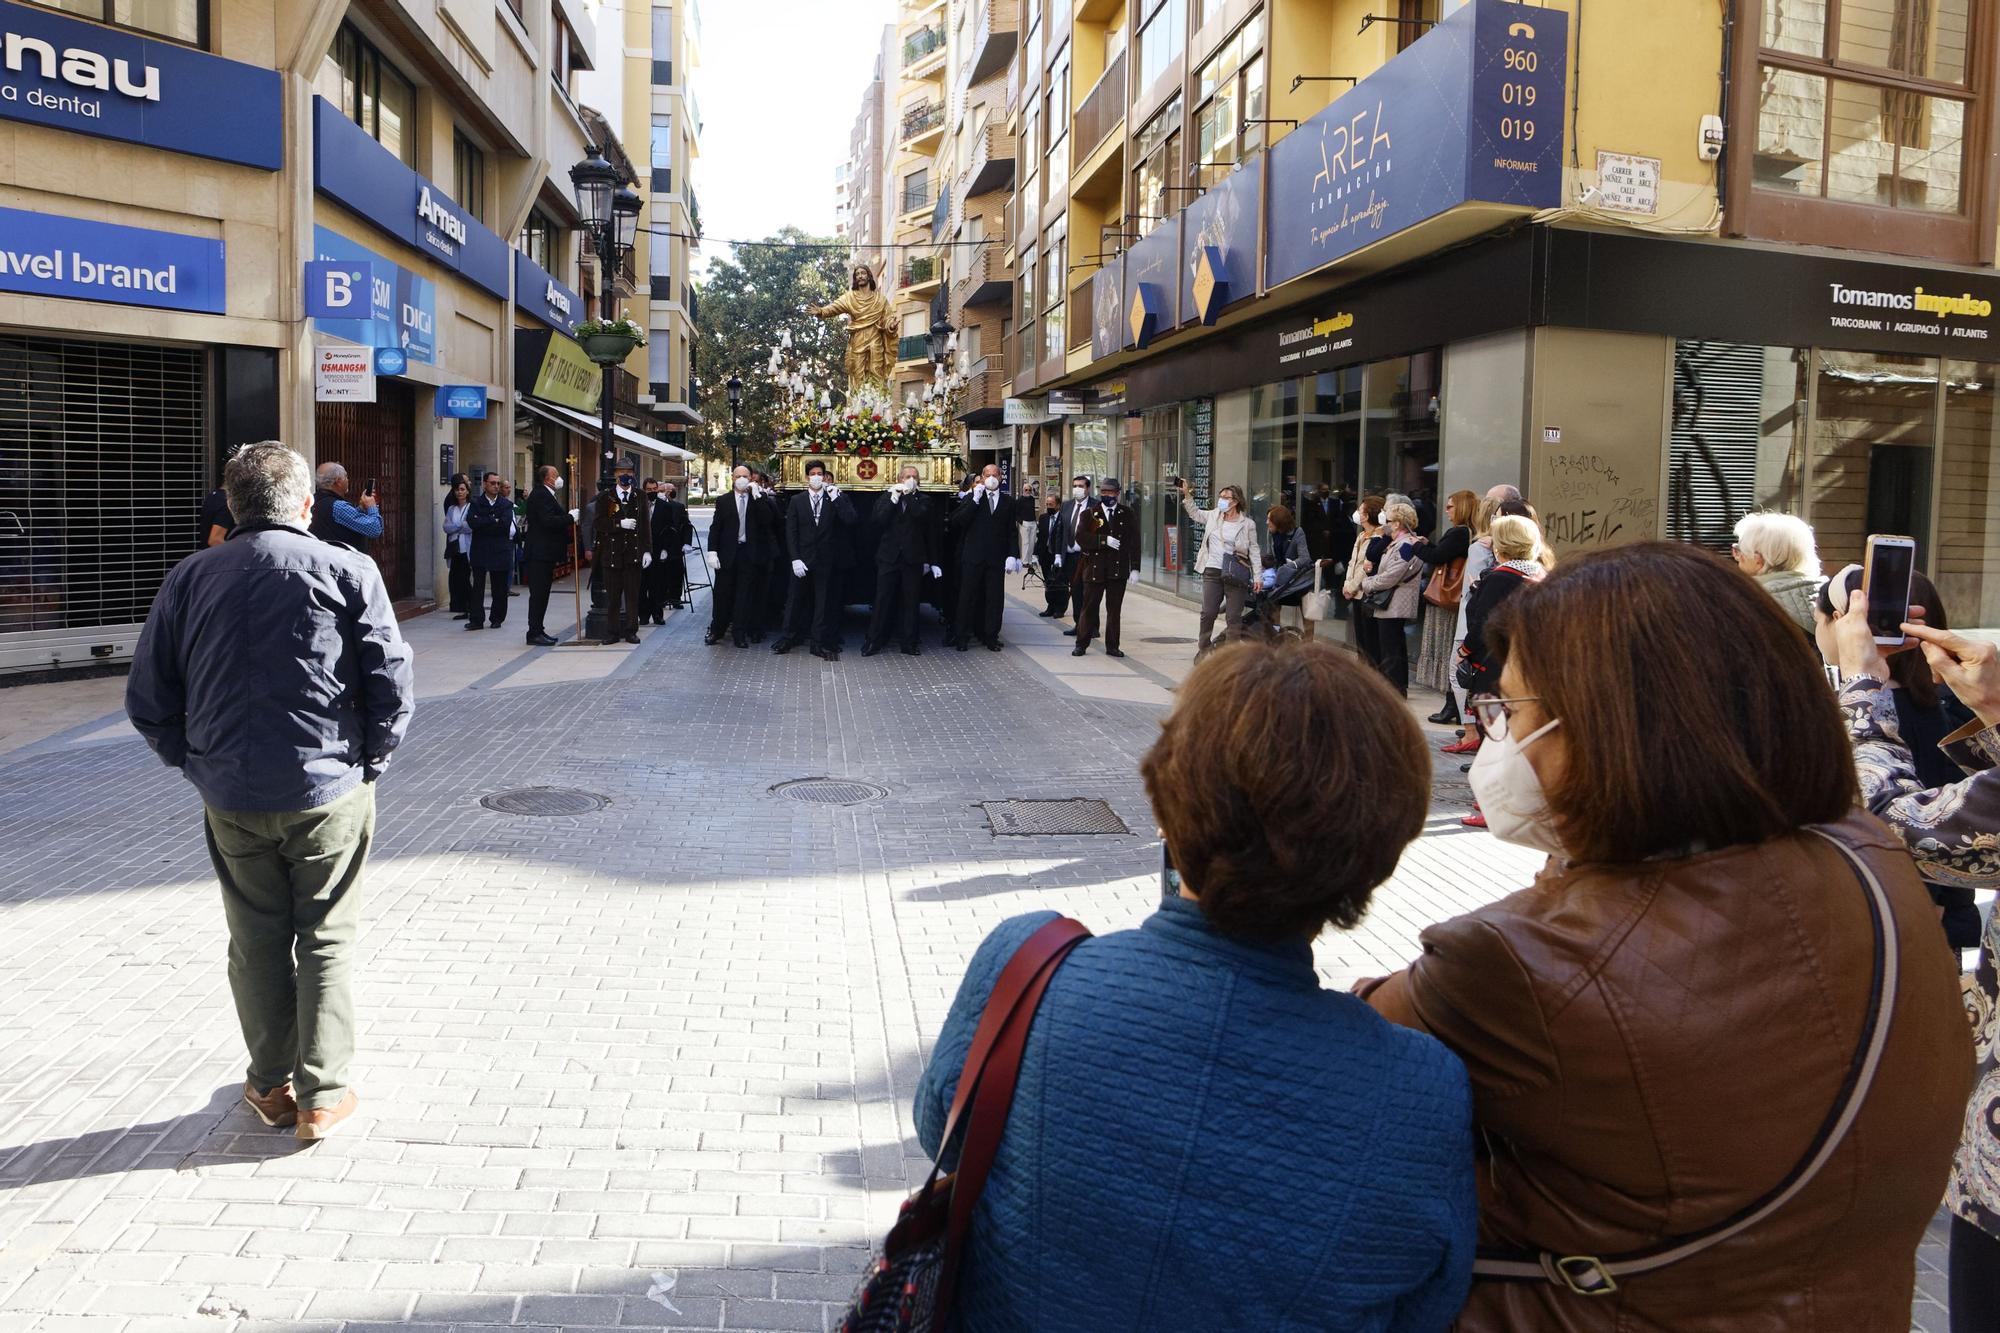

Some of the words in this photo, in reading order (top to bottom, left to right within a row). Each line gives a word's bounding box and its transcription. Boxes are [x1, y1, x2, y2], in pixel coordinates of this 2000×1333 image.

[0, 31, 160, 102] nau
[1503, 47, 1537, 73] 960
[26, 88, 100, 119] dental
[1501, 82, 1536, 107] 019
[1500, 117, 1535, 141] 019
[1312, 100, 1391, 194] ÁREA
[1494, 157, 1538, 173] INFÓRMATE
[1611, 166, 1632, 175] CARRER
[1639, 170, 1645, 178] DE
[1311, 159, 1391, 214] FORMACIÓN
[1639, 179, 1651, 187] ARCE
[417, 186, 466, 246] Arnau
[72, 252, 177, 294] brand
[326, 271, 352, 307] B
[1829, 283, 1913, 311] Tomamos
[1914, 286, 1992, 318] impulso
[402, 303, 432, 335] DIGI
[1278, 327, 1314, 347] Tomamos
[1313, 311, 1353, 338] impulso
[1830, 317, 1882, 331] TARGOBANK
[1894, 322, 1940, 336] AGRUPACIÓ
[1952, 327, 1988, 339] ATLANTIS
[321, 362, 367, 373] USMANGSM
[447, 399, 481, 409] DIGI
